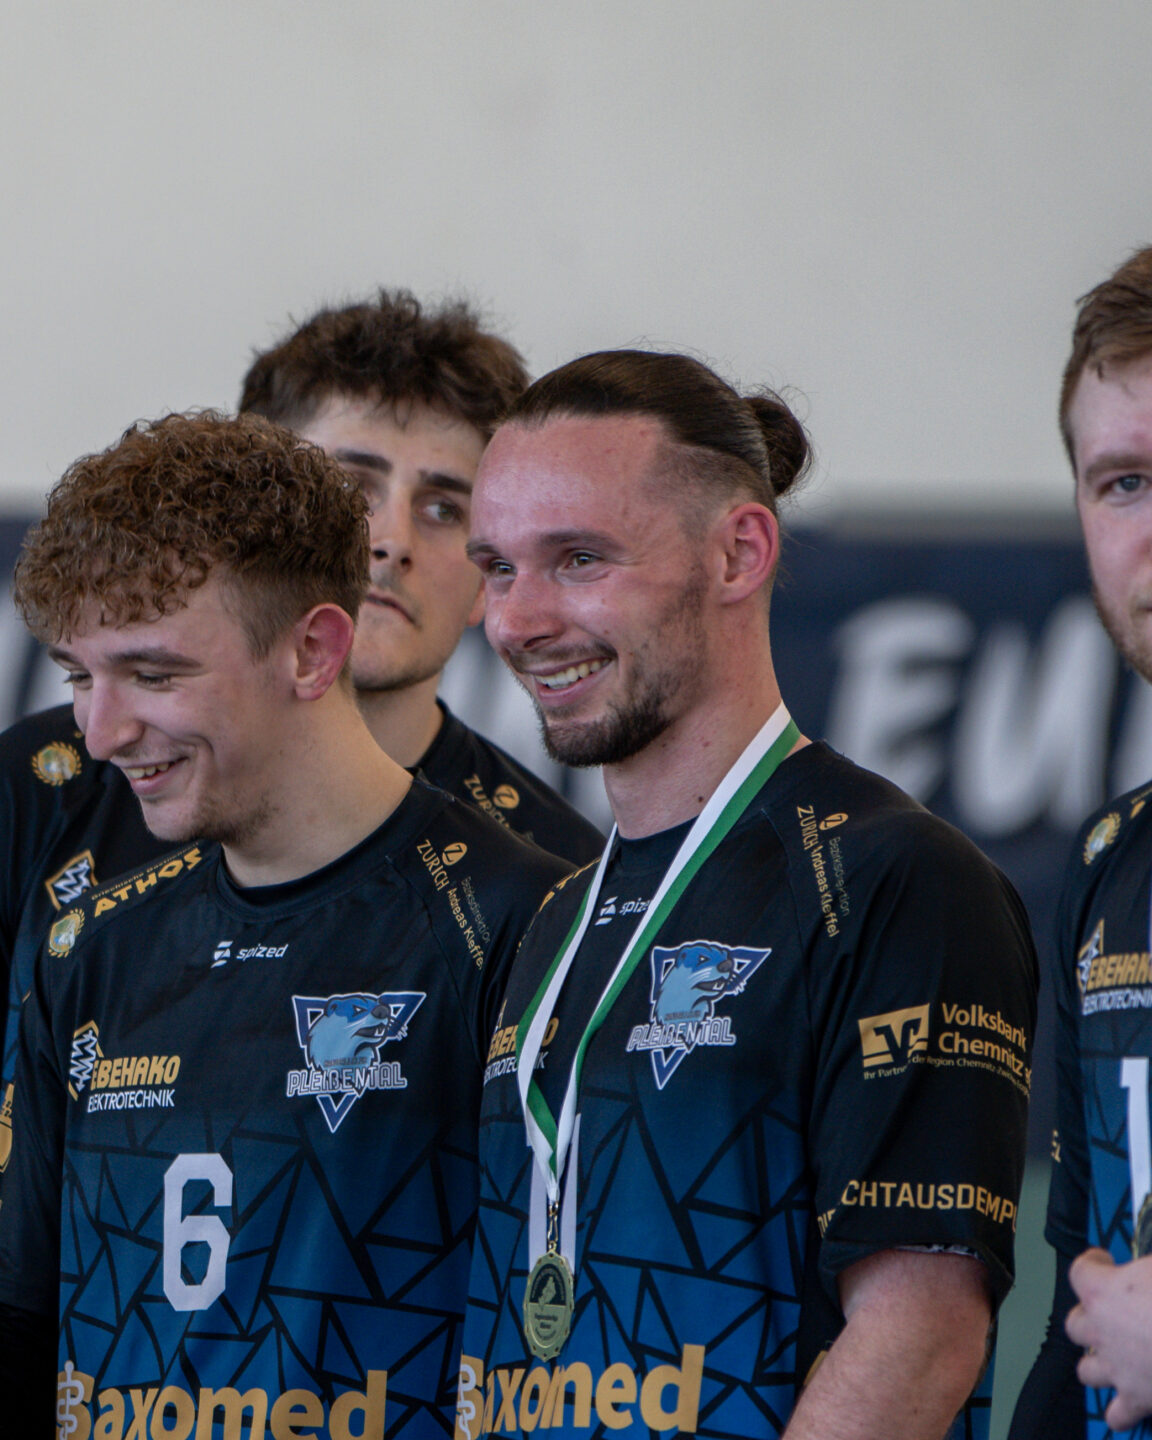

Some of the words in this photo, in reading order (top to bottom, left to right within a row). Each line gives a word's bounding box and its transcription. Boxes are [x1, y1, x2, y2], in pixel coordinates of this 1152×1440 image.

[796, 804, 819, 851] ZURICH
[94, 847, 203, 918] ATHOS
[416, 838, 451, 892] ZURICH
[447, 886, 469, 930] Andreas
[619, 897, 651, 916] spiz
[236, 943, 289, 961] spized
[941, 1001, 1027, 1053] Volksbank
[938, 1031, 1023, 1078] Chemnitz
[163, 1152, 234, 1312] 6
